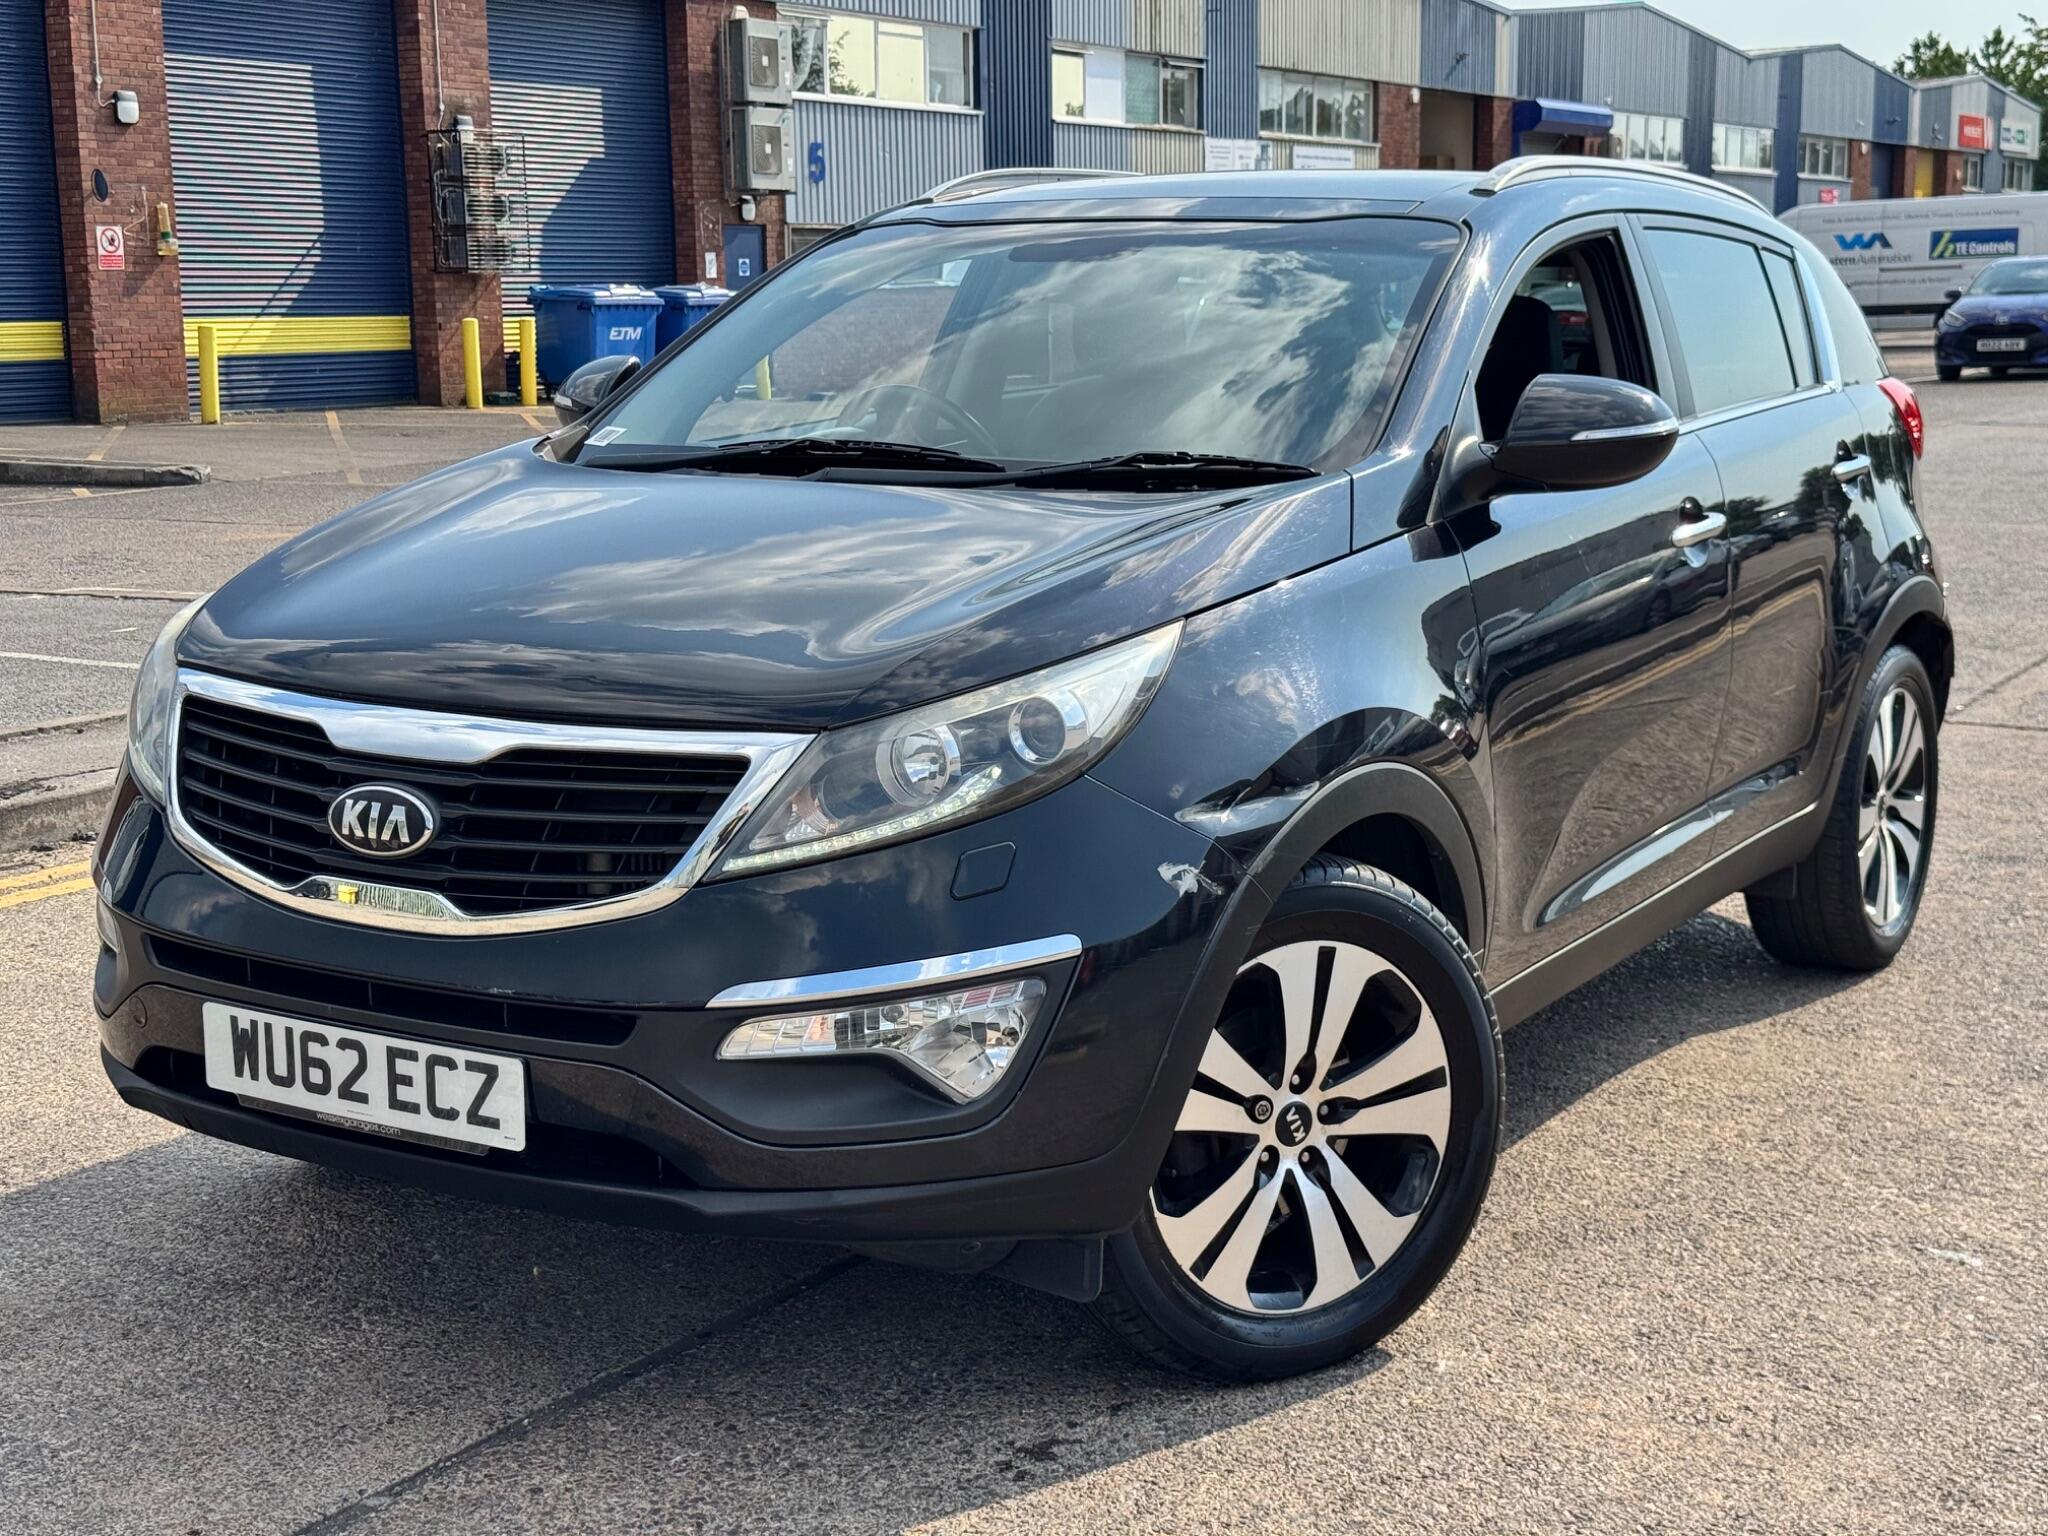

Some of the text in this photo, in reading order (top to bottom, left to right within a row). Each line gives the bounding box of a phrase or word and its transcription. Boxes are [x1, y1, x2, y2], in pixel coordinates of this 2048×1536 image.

[808, 142, 826, 184] 5
[1969, 239, 2016, 255] Controls
[609, 326, 643, 341] ETM
[341, 798, 411, 843] KIA
[229, 1014, 501, 1130] WU62 ECZ
[315, 1110, 401, 1136] wessexgarages.com
[1286, 1106, 1306, 1143] KIA
